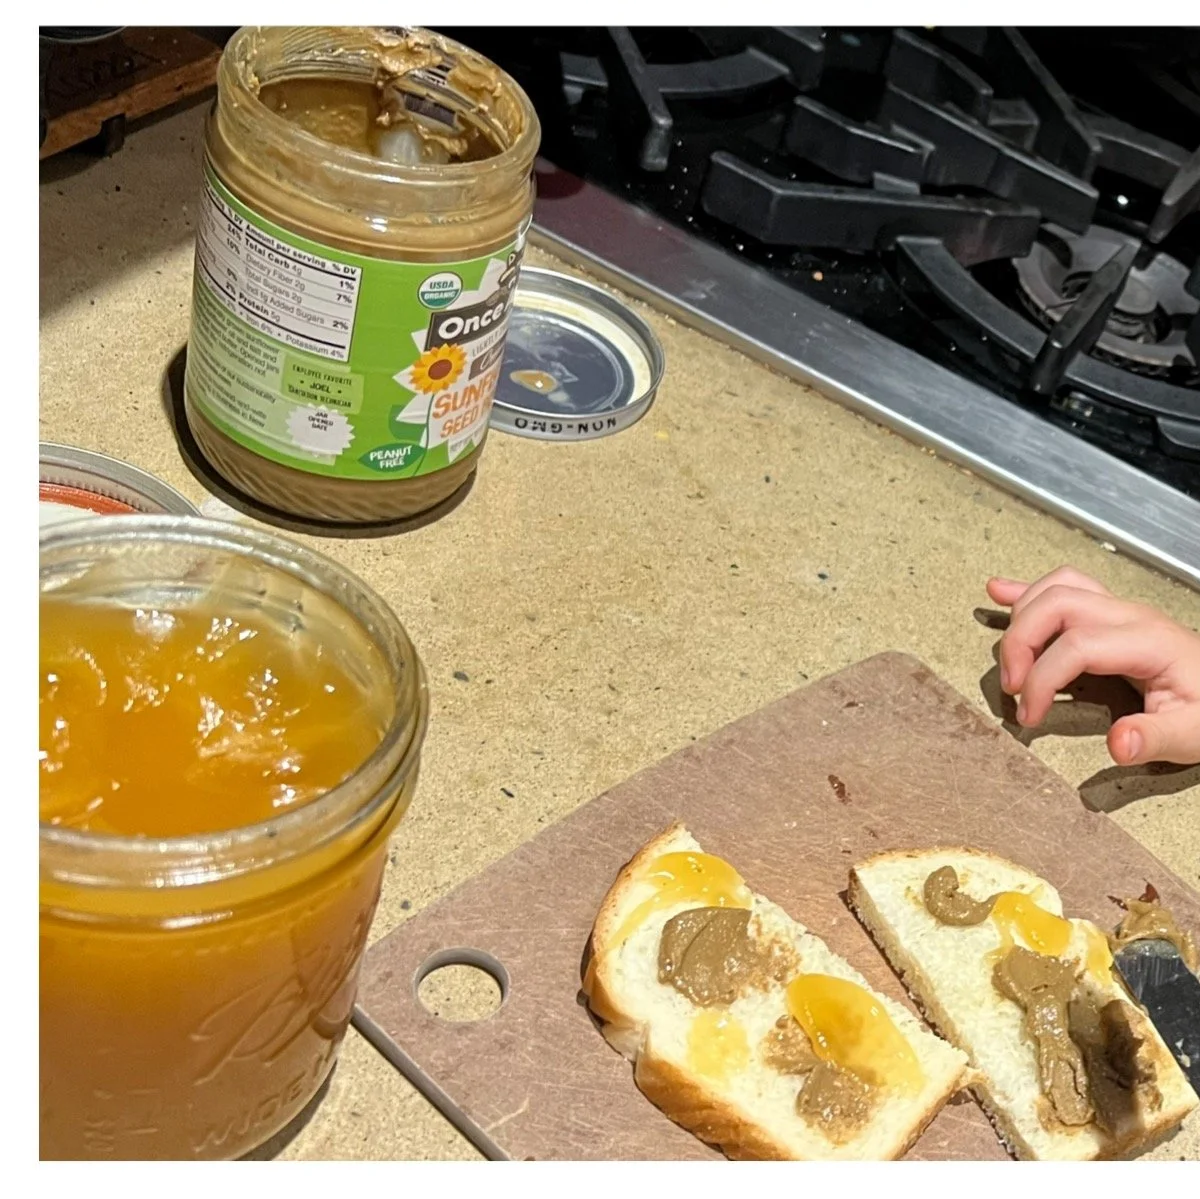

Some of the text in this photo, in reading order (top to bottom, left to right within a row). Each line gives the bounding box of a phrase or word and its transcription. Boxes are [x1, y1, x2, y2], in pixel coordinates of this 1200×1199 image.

[246, 223, 273, 246] Amount
[276, 242, 290, 255] per
[292, 250, 326, 268] serving
[343, 267, 356, 275] DV
[245, 238, 354, 290] Total Carb 4g 1%
[245, 252, 352, 303] Dietary Fiber 2g 7%
[430, 281, 454, 289] USDA
[262, 277, 290, 299] Sugars
[291, 292, 302, 304] 2g
[424, 290, 456, 300] ORGANIC
[239, 291, 269, 316] Protein
[270, 310, 280, 323] 5g
[269, 296, 294, 313] Added
[295, 308, 324, 325] Sugars
[332, 320, 348, 330] 2%
[438, 302, 504, 340] Once
[285, 334, 328, 354] Potassium
[330, 349, 344, 358] 4%
[292, 363, 352, 385] EMPLOYEE FAVORITE
[310, 381, 330, 393] JOEL
[308, 415, 333, 426] OPENED
[311, 422, 327, 431] DATE
[440, 406, 479, 438] SEED
[514, 417, 617, 434] NON-GMO
[369, 445, 413, 461] PEANUT
[380, 457, 405, 469] FREE
